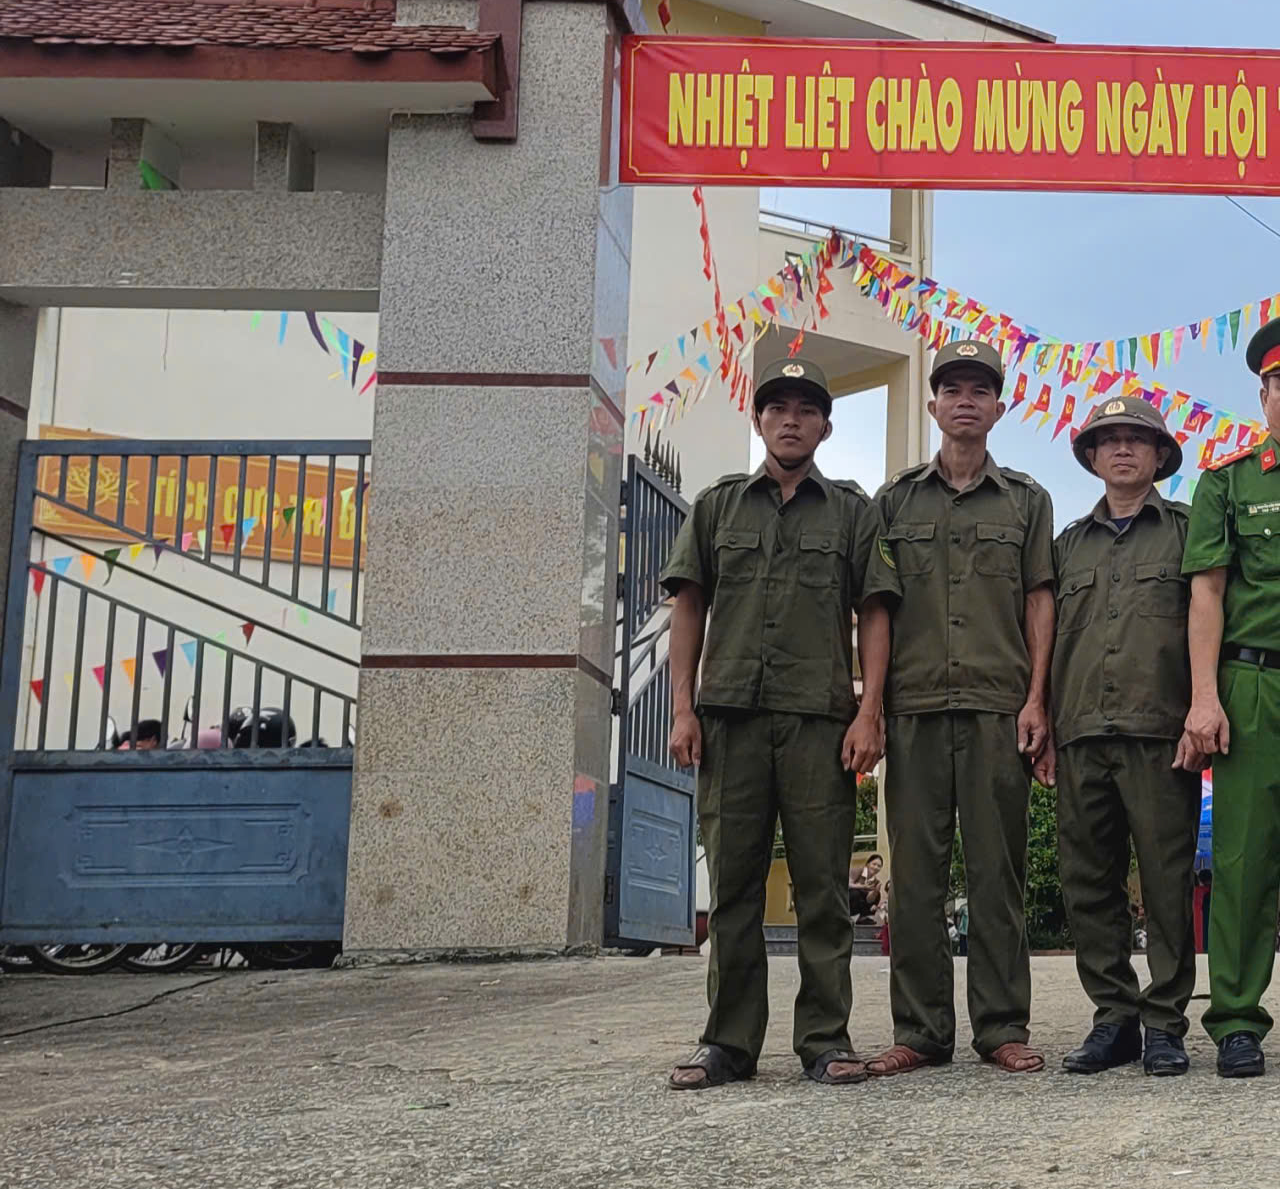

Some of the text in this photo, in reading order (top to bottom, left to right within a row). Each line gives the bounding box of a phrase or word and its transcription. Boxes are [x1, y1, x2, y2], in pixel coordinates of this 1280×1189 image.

[668, 57, 775, 170] NHIỆT
[784, 61, 856, 172] LIỆT
[866, 62, 964, 155] CHÀO
[973, 62, 1085, 156] MỪNG
[1096, 67, 1195, 158] NGÀY
[1204, 69, 1268, 180] HỘI
